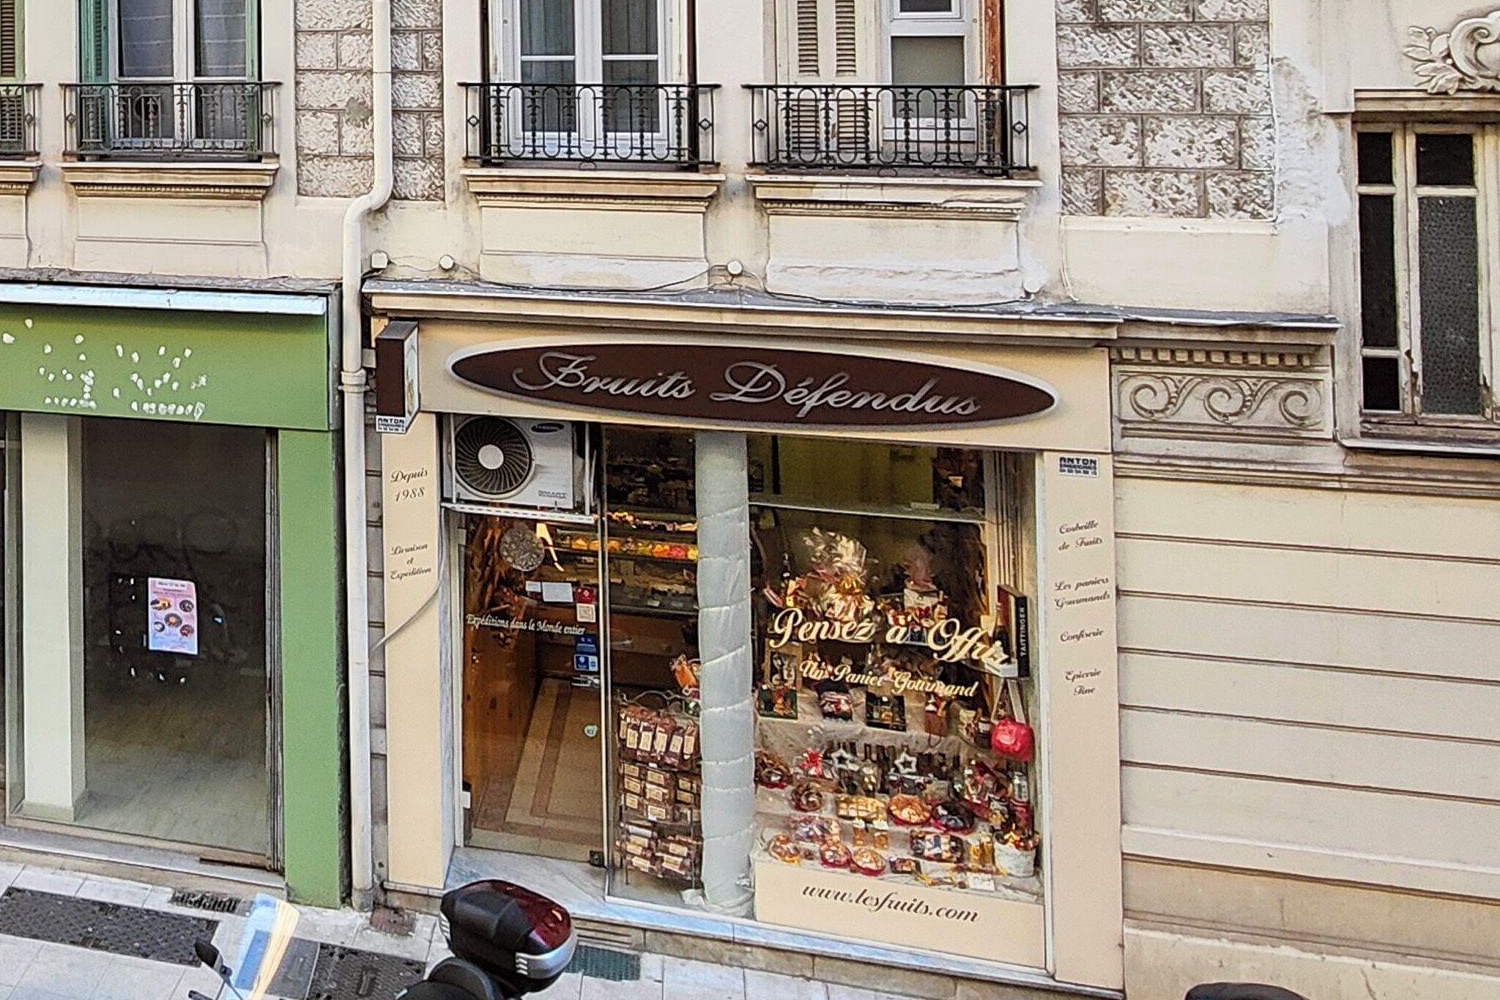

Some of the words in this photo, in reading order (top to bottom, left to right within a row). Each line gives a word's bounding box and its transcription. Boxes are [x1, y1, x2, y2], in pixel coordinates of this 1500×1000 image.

[512, 351, 696, 399] Fruits
[708, 360, 982, 418] Défendus
[377, 417, 405, 425] ANTON
[1059, 456, 1097, 466] ANTON
[390, 467, 428, 484] Depuis
[395, 486, 426, 502] 1988
[390, 543, 428, 555] Livraison
[1058, 541, 1071, 551] de
[1075, 536, 1103, 548] Fruits
[1055, 580, 1072, 591] Les
[1074, 577, 1109, 591] paniers
[1054, 590, 1110, 610] Gourmands
[510, 617, 528, 631] dans
[528, 618, 536, 631] le
[536, 621, 562, 634] Monde
[563, 624, 586, 636] entier
[769, 607, 875, 648] Pensez
[1019, 606, 1028, 658] TAITTINGER
[1060, 628, 1105, 642] Confiserie
[831, 663, 883, 687] Panier
[891, 670, 980, 698] Gourmand
[1074, 685, 1096, 696] Fine
[802, 885, 980, 923] www.lesfruits.com
